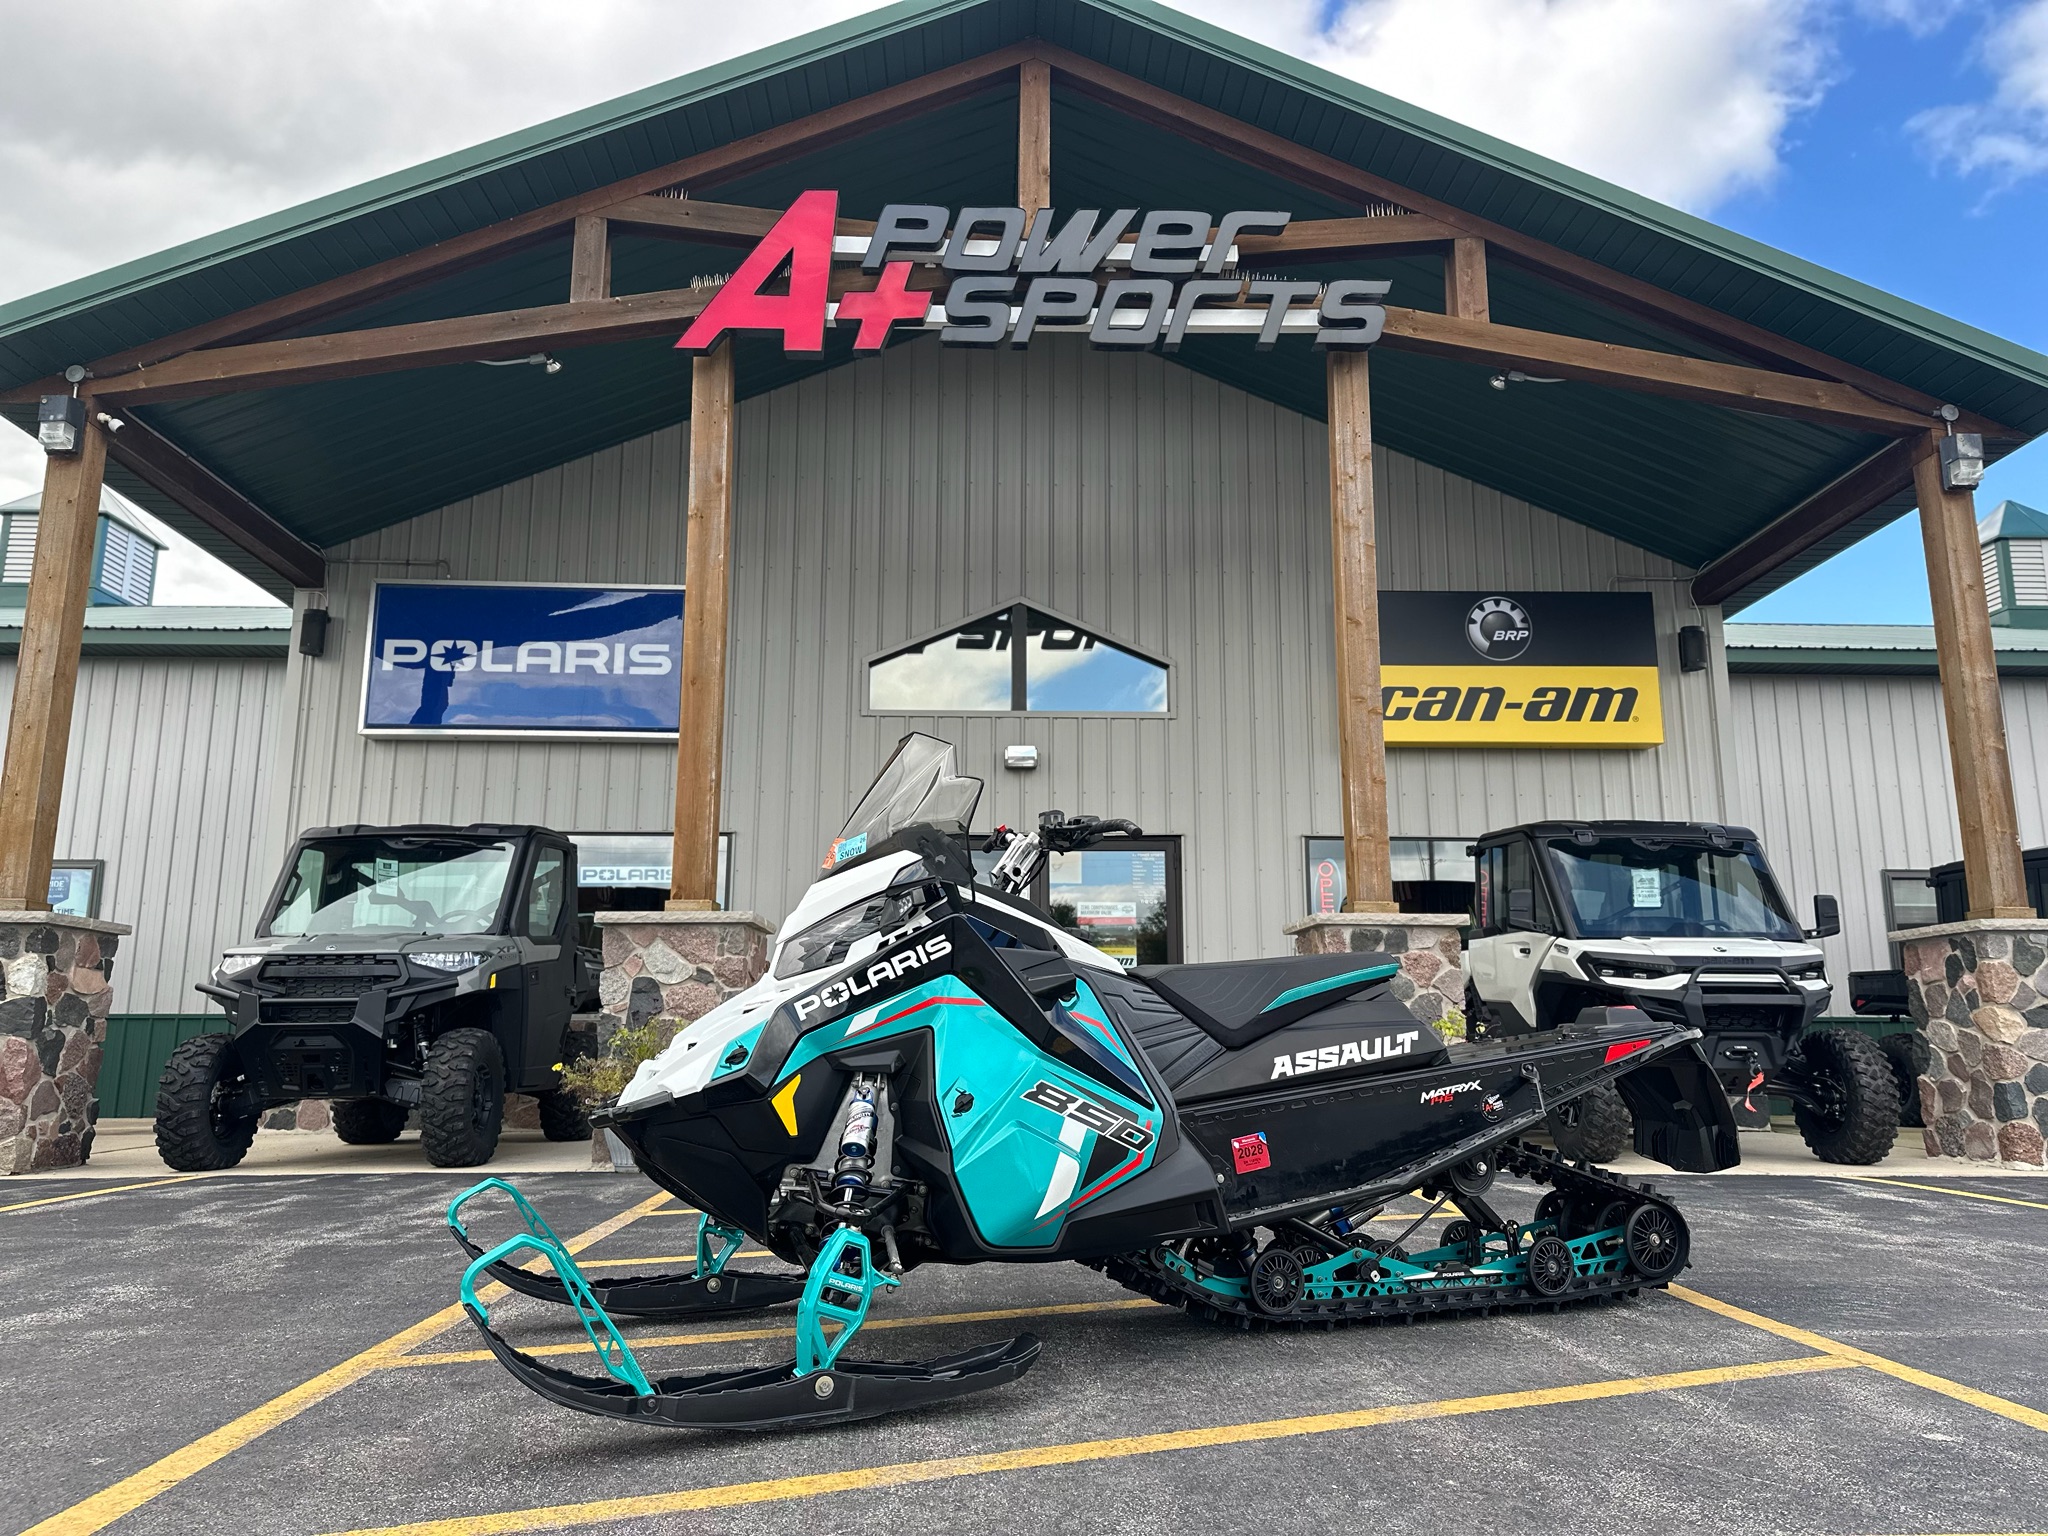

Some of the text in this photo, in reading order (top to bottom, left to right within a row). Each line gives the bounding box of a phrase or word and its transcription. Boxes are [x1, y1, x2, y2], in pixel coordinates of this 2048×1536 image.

[674, 188, 932, 358] A+
[1492, 629, 1530, 642] BRP
[381, 638, 672, 676] POLARIS
[1381, 686, 1639, 723] can-am
[839, 845, 863, 860] SNOW
[497, 945, 516, 955] XP
[297, 966, 360, 976] POLARIS
[793, 934, 953, 1022] POLARIS
[1270, 1030, 1419, 1080] ASSAULT
[1420, 1080, 1483, 1104] MATRYX
[1429, 1093, 1454, 1105] 146
[1019, 1079, 1155, 1154] 850
[1237, 1143, 1264, 1159] 2028
[828, 1278, 864, 1293] POLARIS
